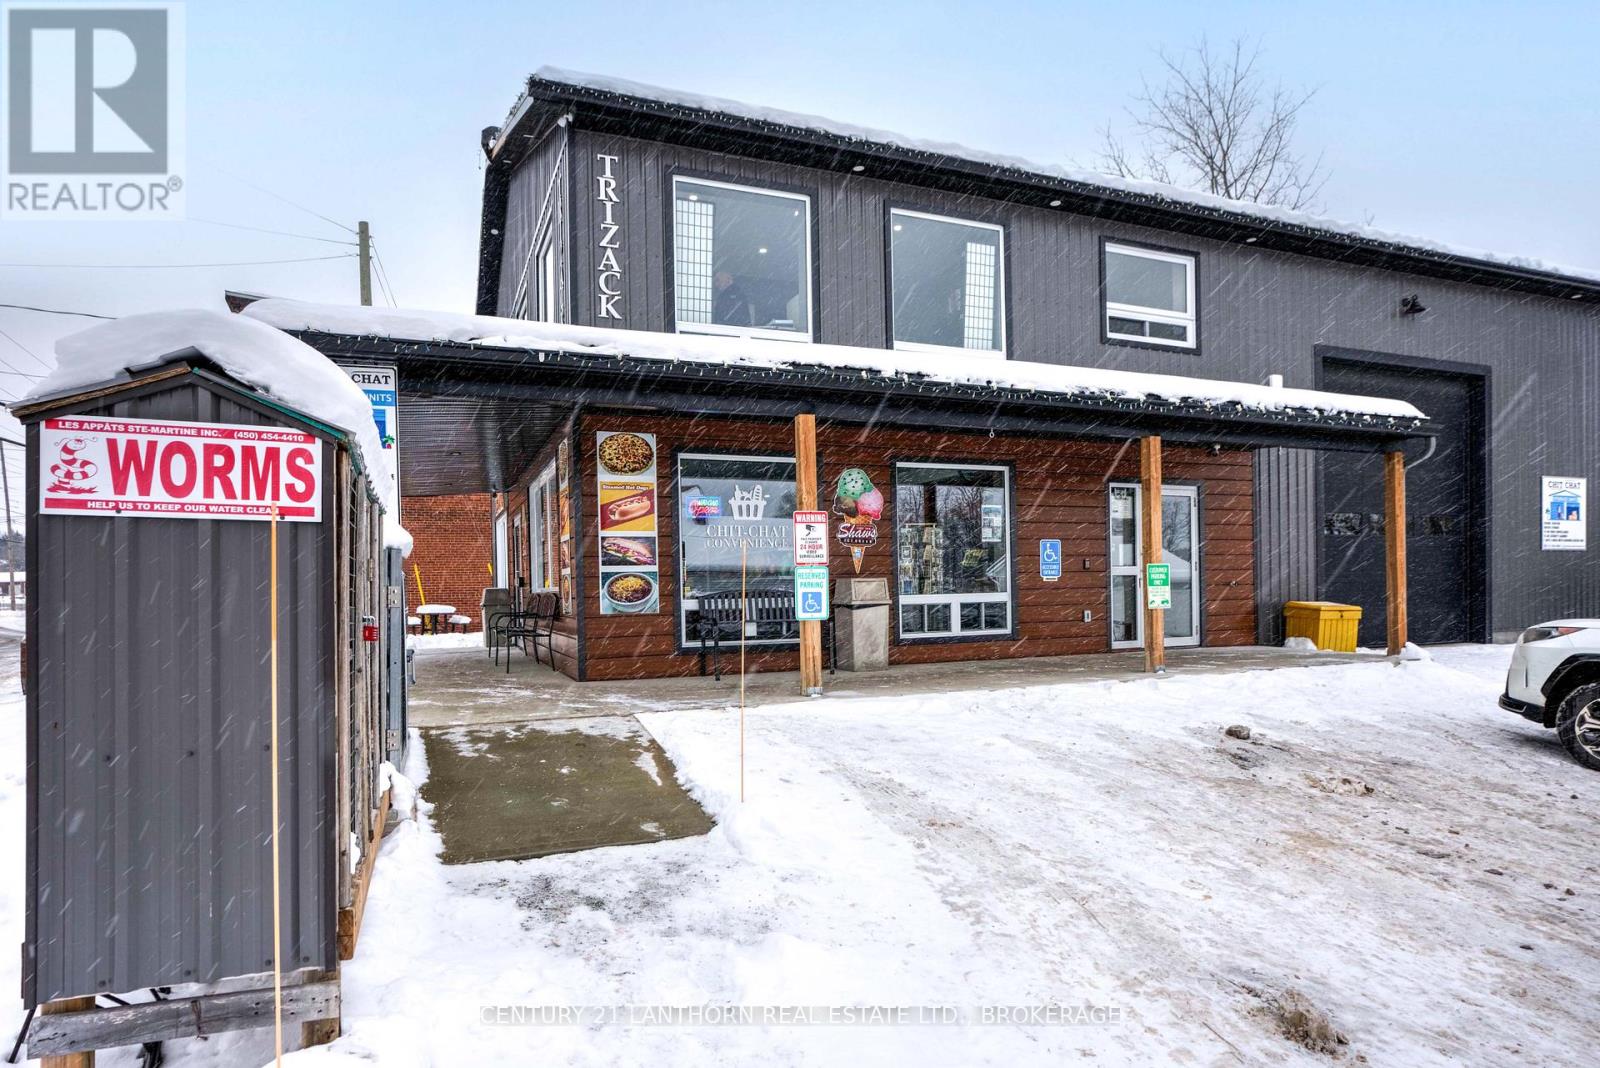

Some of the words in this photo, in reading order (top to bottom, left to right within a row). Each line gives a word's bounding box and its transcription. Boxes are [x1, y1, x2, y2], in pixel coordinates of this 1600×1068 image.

[596, 153, 622, 319] TRIZACK
[351, 373, 391, 385] CHAT
[366, 393, 392, 402] NITS
[58, 421, 80, 429] LES
[82, 421, 125, 432] APPÂTS
[127, 425, 198, 436] STE-MARTINE
[200, 429, 222, 437] INC.
[233, 431, 259, 440] (450)
[260, 432, 304, 442] 454-4410
[106, 437, 316, 503] WORMS
[87, 501, 115, 509] HELP
[118, 501, 134, 510] US
[137, 502, 151, 510] TO
[153, 502, 181, 511] KEEP
[184, 504, 206, 512] OUR
[208, 505, 244, 513] WATER
[796, 514, 826, 522] WARNING
[706, 525, 789, 537] CHIT-CHAT
